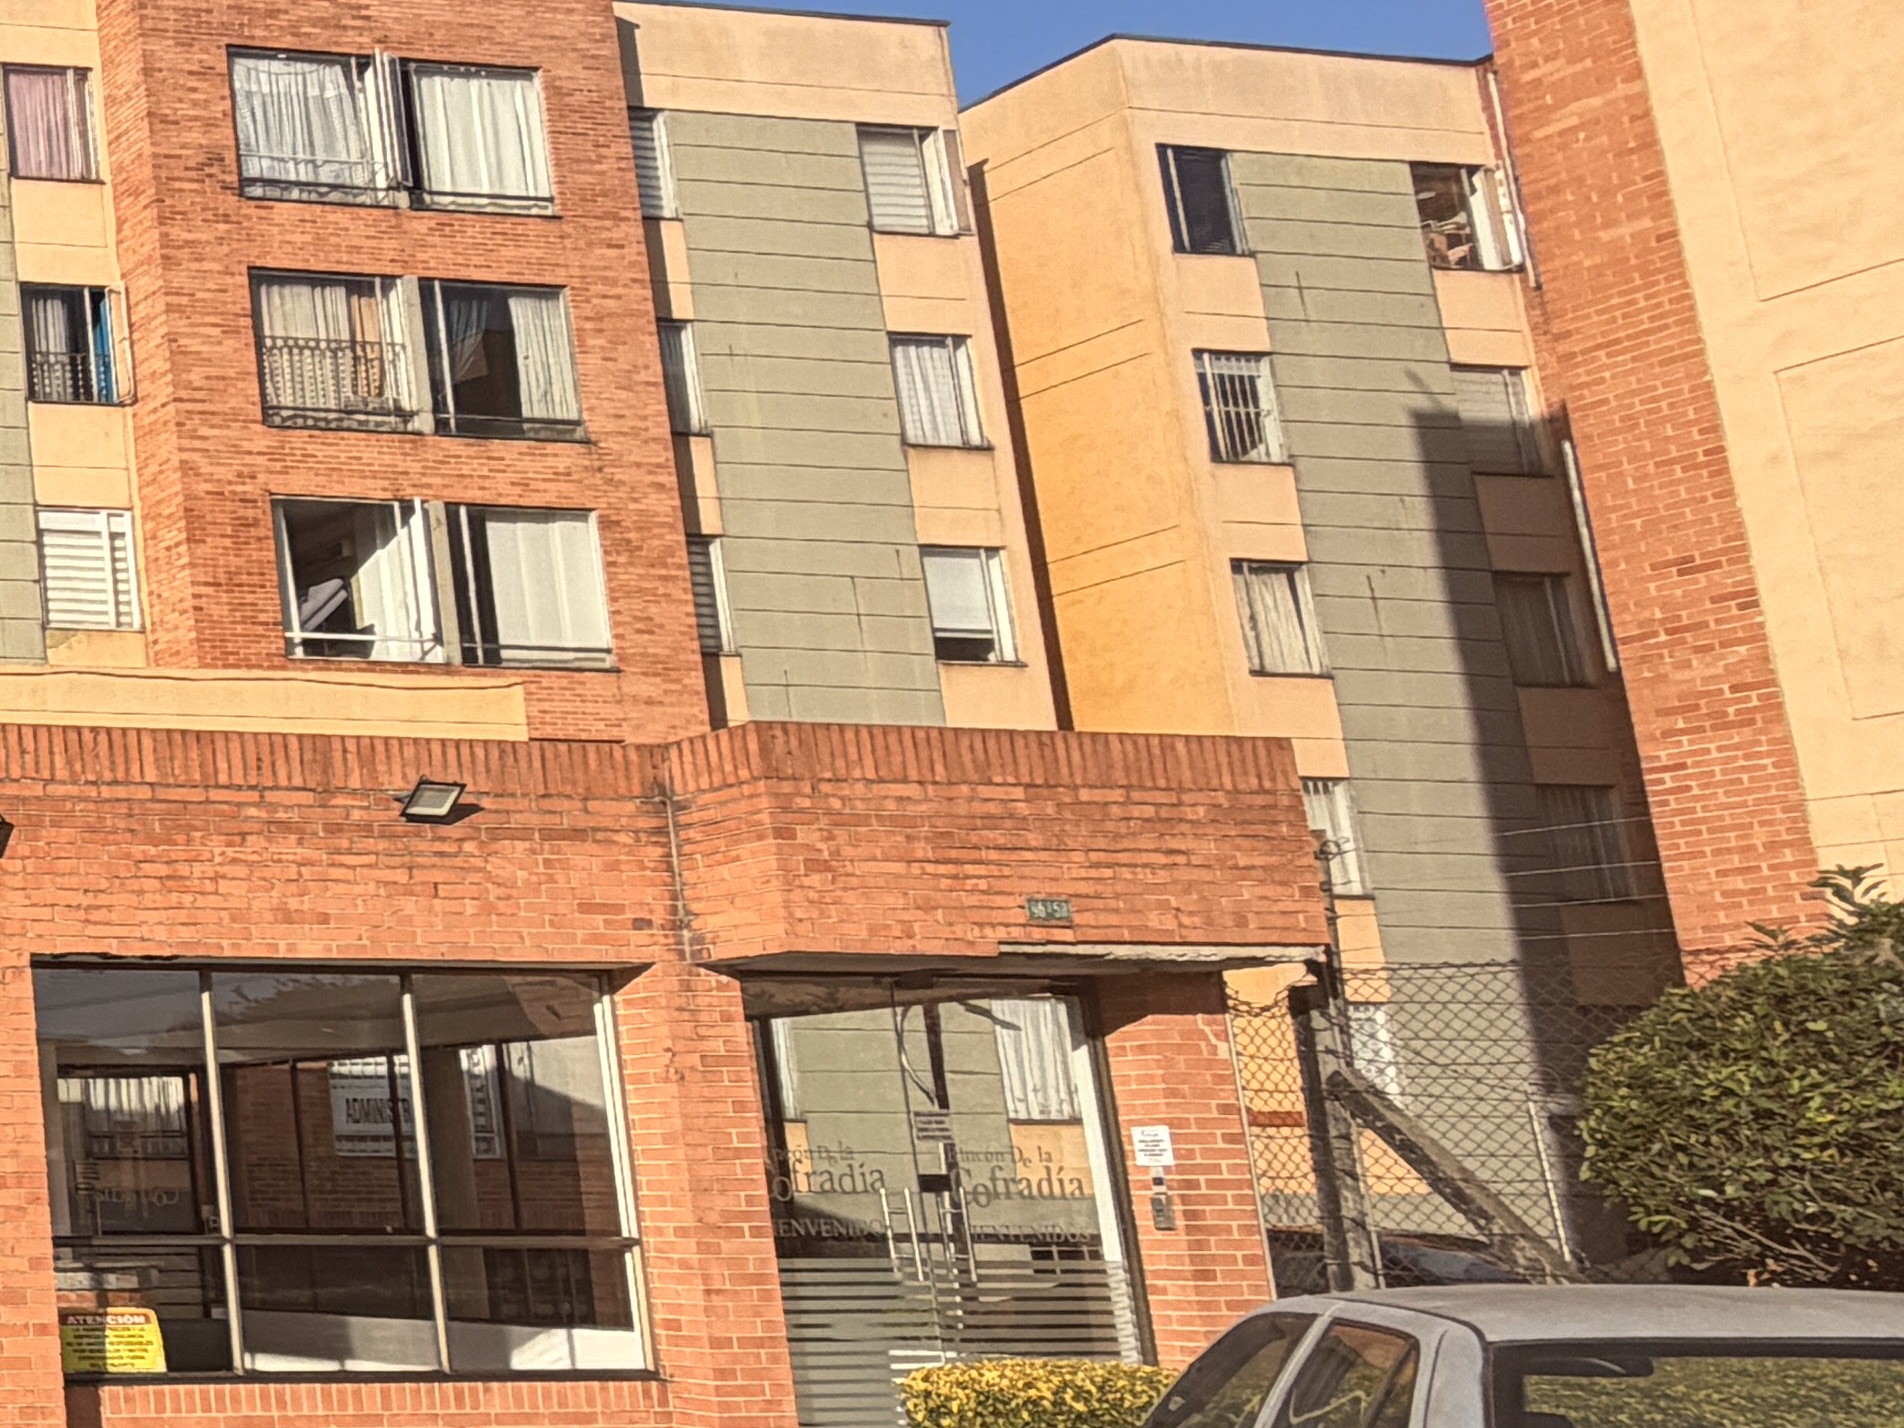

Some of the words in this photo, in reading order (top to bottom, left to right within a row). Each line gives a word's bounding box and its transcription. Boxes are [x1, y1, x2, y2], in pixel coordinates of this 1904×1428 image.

[1011, 1145, 1033, 1168] De
[1037, 1144, 1054, 1163] la
[765, 1158, 886, 1202] ofradía
[950, 1164, 1087, 1208] Cofradía
[973, 1224, 1090, 1242] IENVENIDOS
